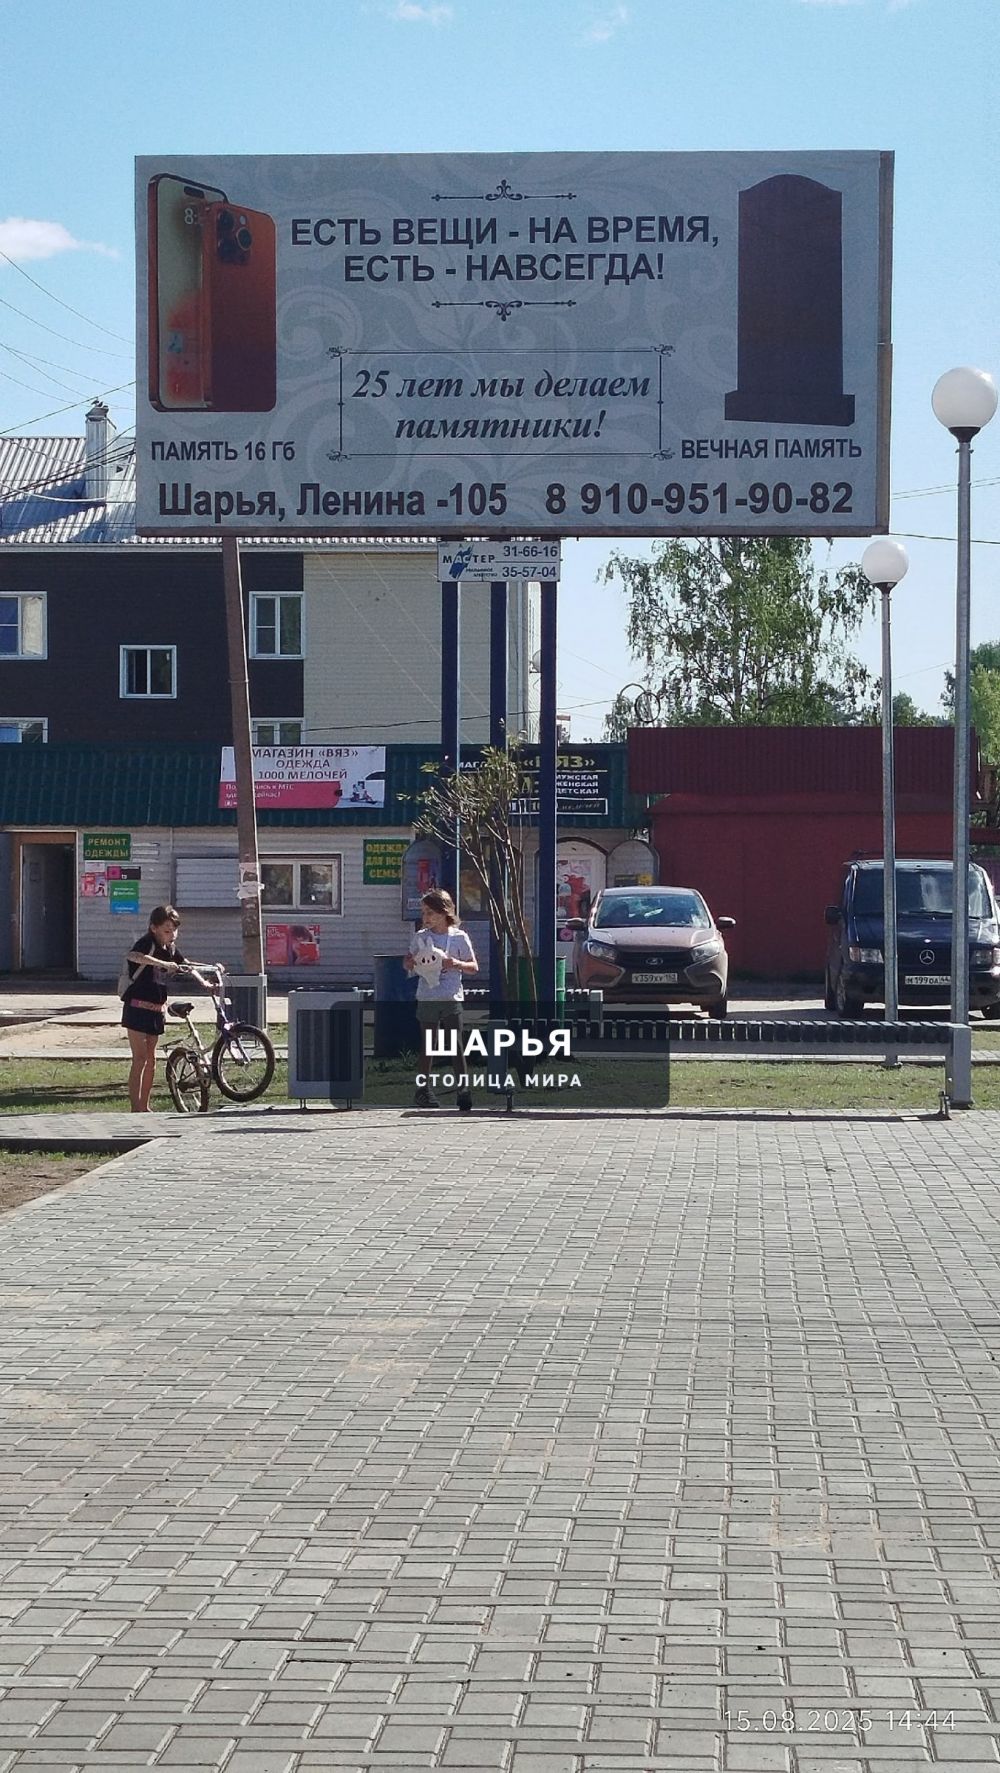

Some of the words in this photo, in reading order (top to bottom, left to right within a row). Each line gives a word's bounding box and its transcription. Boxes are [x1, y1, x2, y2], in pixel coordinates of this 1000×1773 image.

[291, 218, 382, 246] ЕСТЬ
[392, 217, 497, 250] ВЕЩИ
[529, 216, 577, 244] НА
[587, 215, 719, 247] ВРЕМЯ,
[345, 255, 435, 282] ЕСТЬ
[466, 253, 664, 285] НАВСЕГДА!
[352, 370, 391, 398] 25
[396, 379, 462, 398] лет
[471, 379, 524, 398] мы
[534, 369, 650, 397] делаем
[395, 410, 607, 439] памятники!
[151, 441, 238, 462] ПАМЯТЬ
[245, 441, 266, 461] 16
[272, 440, 295, 461] Гб
[681, 439, 769, 459] ВЕЧНАЯ
[774, 438, 862, 459] ПАМЯТЬ
[159, 483, 286, 523] Шарья,
[296, 482, 426, 517] Ленина
[436, 482, 508, 516] -105
[545, 483, 566, 515] 8
[580, 482, 853, 515] 910-951-90-82
[442, 554, 495, 564] МАСТЕР
[503, 545, 559, 557] 31-66-16
[502, 566, 557, 578] 35-57-04
[319, 748, 359, 758] «ВЯЗ»
[276, 759, 331, 769] ОДЕЖДА
[259, 771, 285, 780] 1000
[288, 768, 348, 780] МЕЛОЧЕЙ
[88, 838, 128, 847] РЕМОНТ
[85, 848, 129, 859] ОДЕЖДЫ
